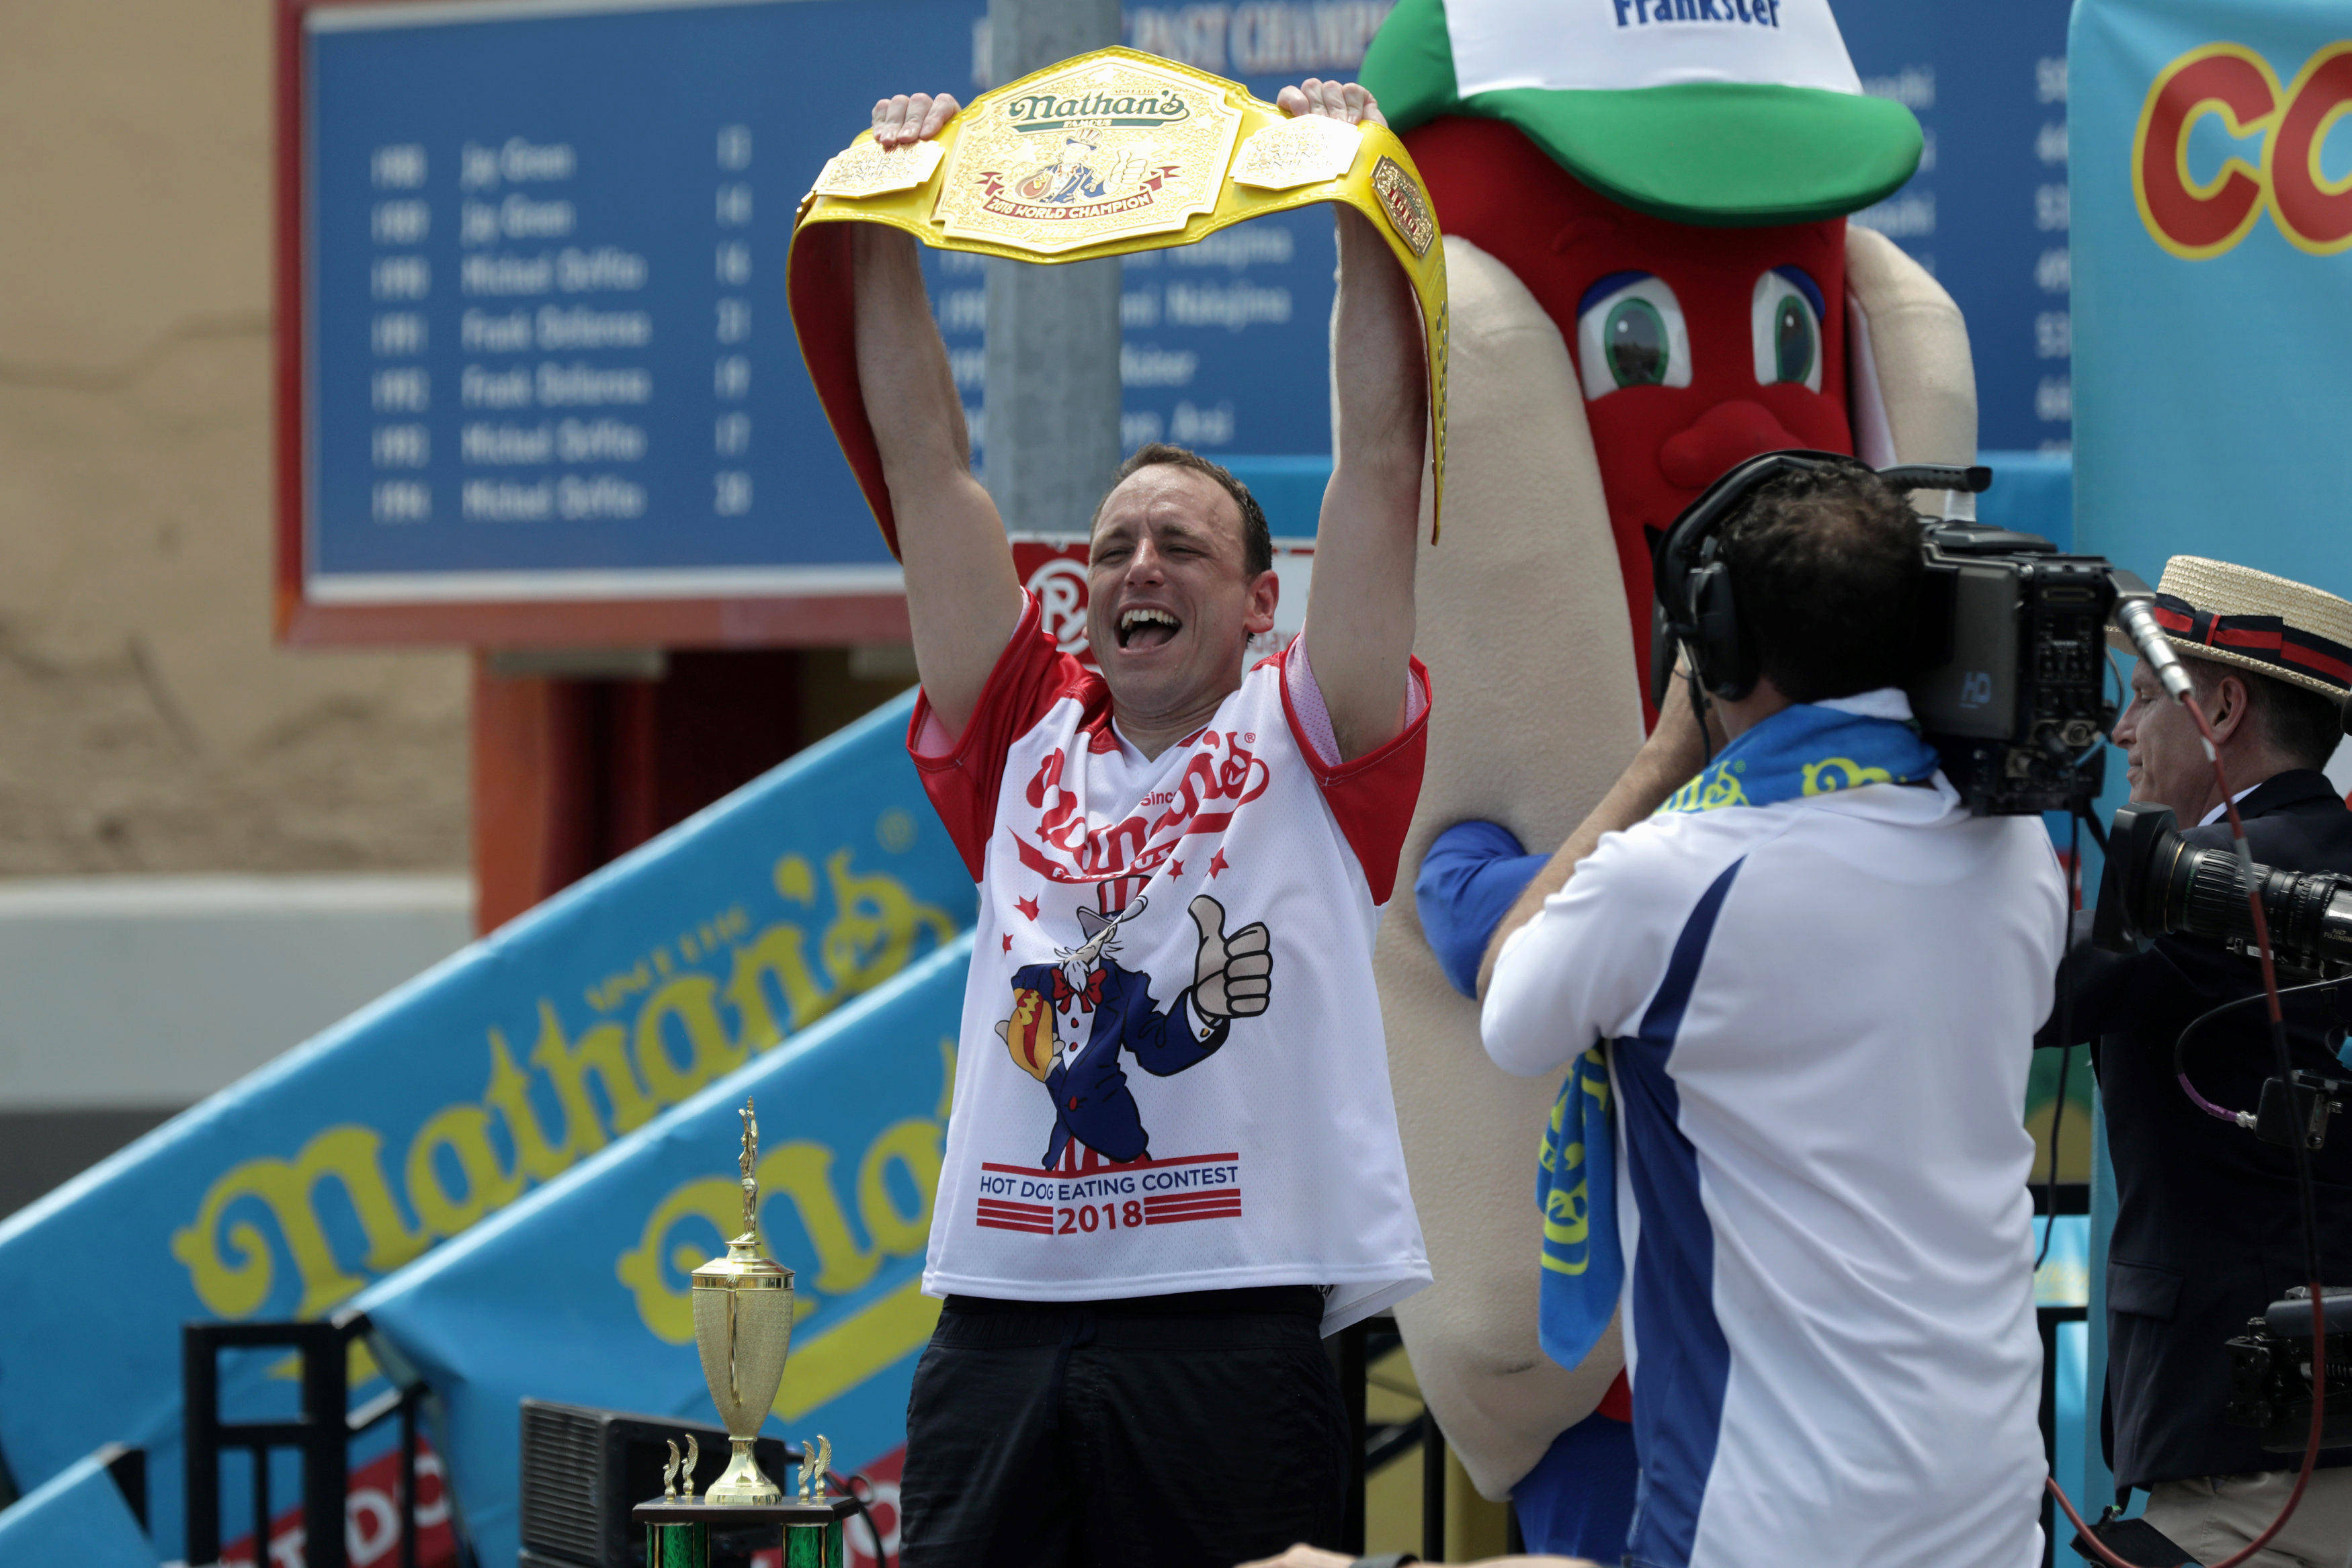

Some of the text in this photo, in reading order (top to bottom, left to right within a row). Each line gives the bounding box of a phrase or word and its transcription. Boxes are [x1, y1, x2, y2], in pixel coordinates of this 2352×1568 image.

[1613, 0, 1780, 28] Frankster
[1009, 89, 1189, 120] Nathan's
[989, 193, 1152, 219] 2018 WORLD CHAMPION
[1962, 671, 1992, 703] HD
[1140, 791, 1177, 806] Sinc
[172, 849, 958, 1322] Nathan's
[616, 1038, 956, 1344] Na
[980, 1166, 1239, 1201] HOT DOG EATING CONTEST
[1057, 1200, 1144, 1235] 2018
